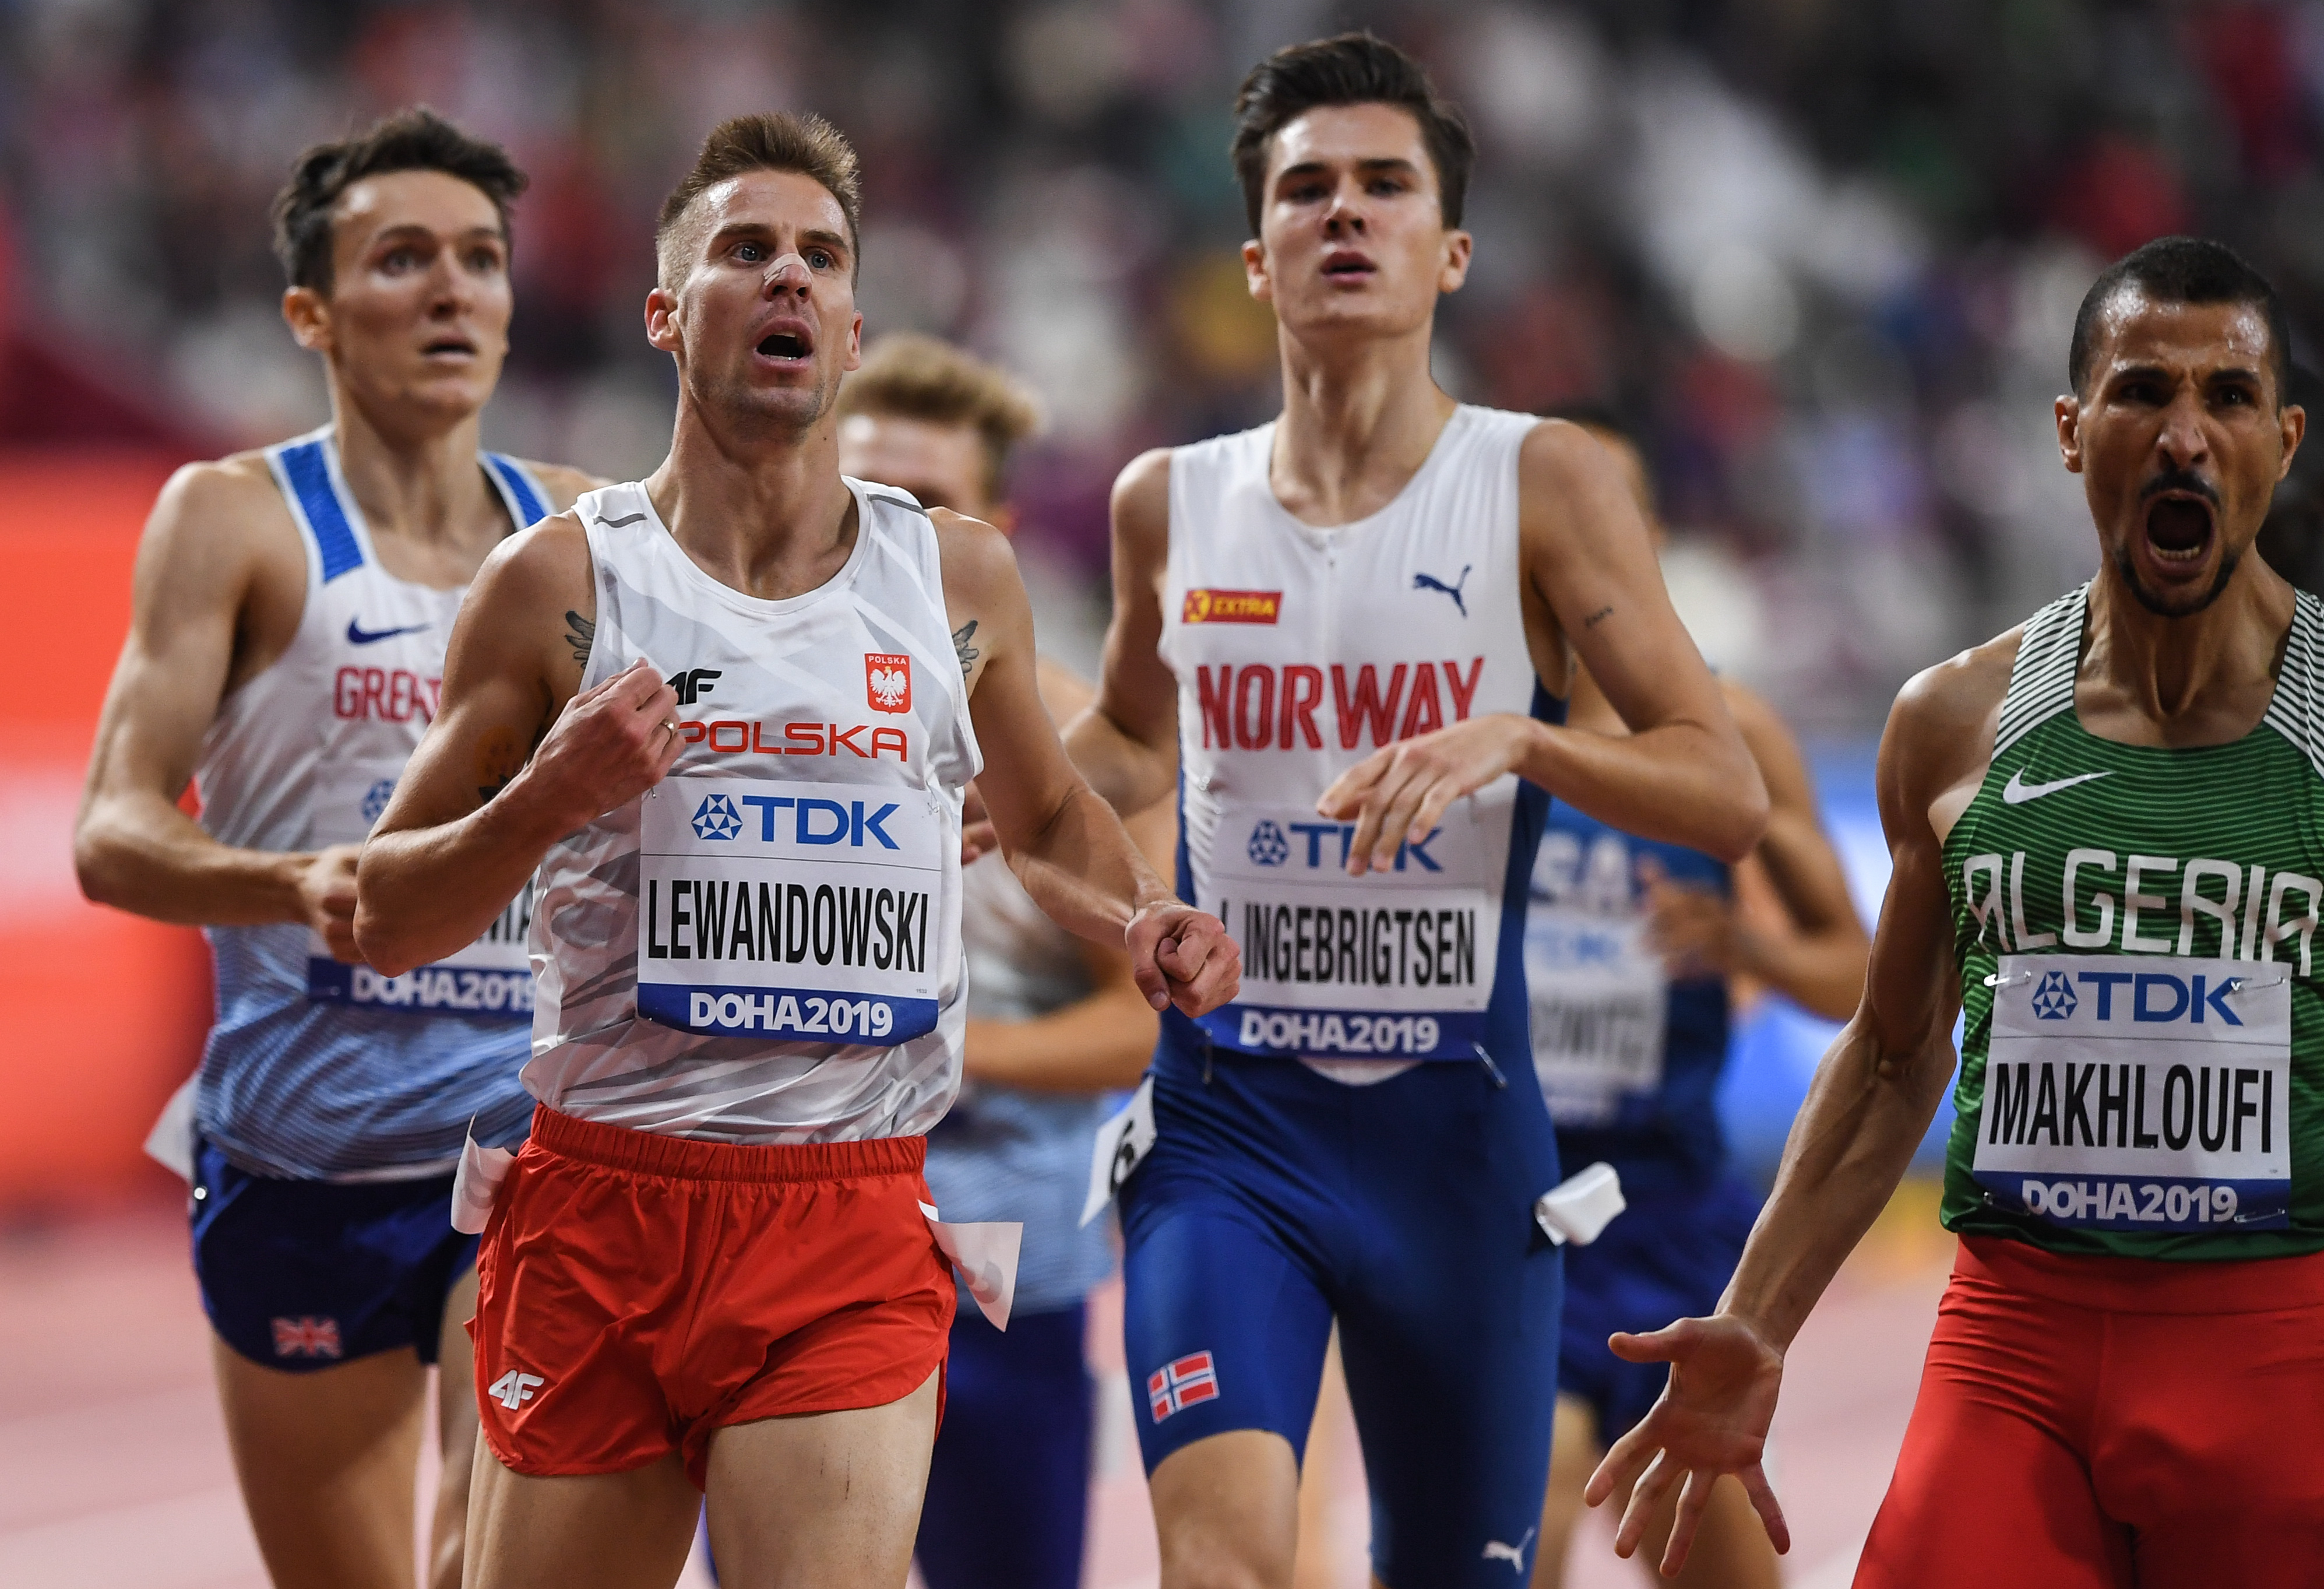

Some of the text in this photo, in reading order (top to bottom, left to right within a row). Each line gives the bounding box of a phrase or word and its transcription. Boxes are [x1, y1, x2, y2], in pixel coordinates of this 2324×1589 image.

[868, 656, 907, 665] POLSKA
[1197, 657, 1484, 750] NORWAY
[678, 720, 907, 762] POLSKA
[742, 795, 900, 850] TDK
[647, 879, 928, 973] LEWANDOWSKI
[1963, 848, 2323, 977] ALGERIA
[1244, 903, 1476, 986] INGEBRIGTSEN
[690, 992, 893, 1036] DOHA2019
[2078, 972, 2253, 1026] TDK
[1239, 1010, 1439, 1053] DOHA2019
[1988, 1062, 2273, 1154] MAKHLOUFI
[2022, 1179, 2238, 1222] DOHA2019
